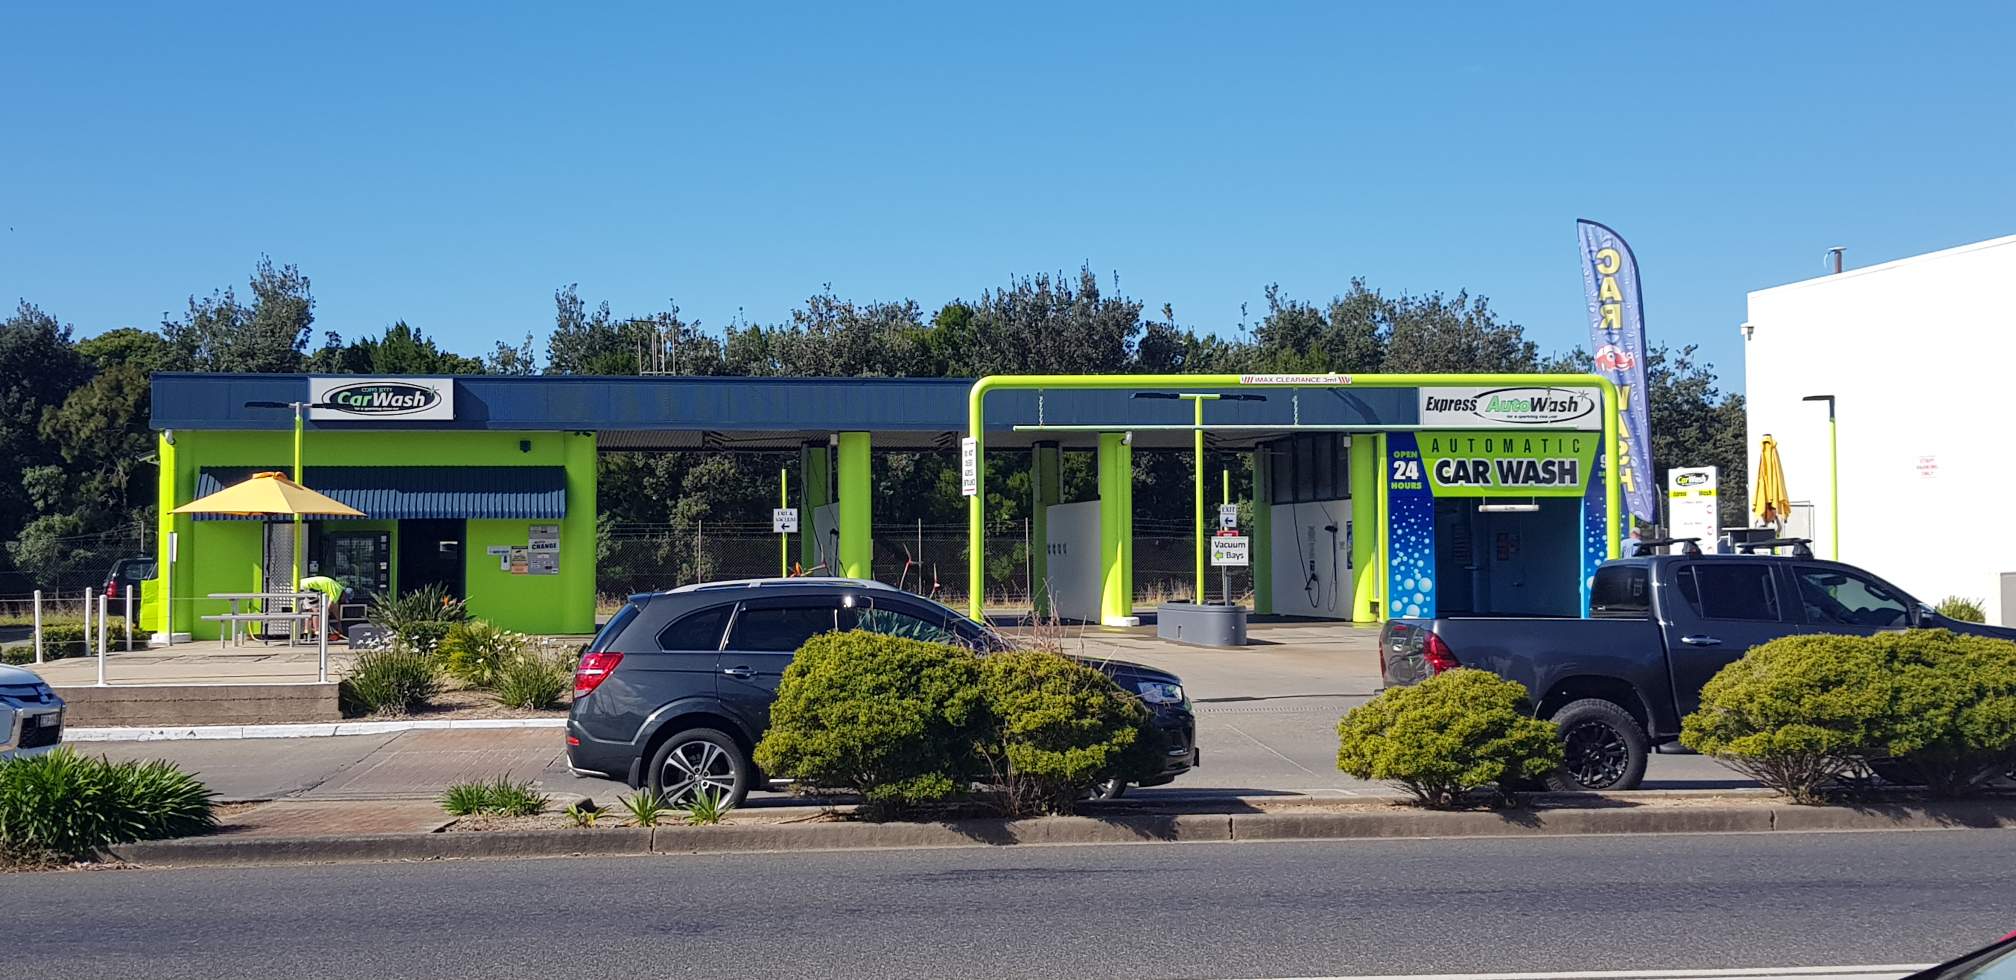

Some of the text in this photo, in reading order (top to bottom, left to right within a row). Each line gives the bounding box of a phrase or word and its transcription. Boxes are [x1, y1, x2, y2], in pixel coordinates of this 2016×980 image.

[337, 391, 426, 407] CarWash
[1425, 396, 1478, 413] Express
[1431, 438, 1580, 453] AUTOMATIC
[1393, 451, 1418, 459] OPEN
[1393, 461, 1419, 480] 24
[1434, 459, 1492, 486] CAR
[1495, 459, 1578, 486] WASH
[1391, 482, 1422, 490] HOURS
[1214, 540, 1246, 548] Vacuum
[1226, 551, 1244, 560] Bays
